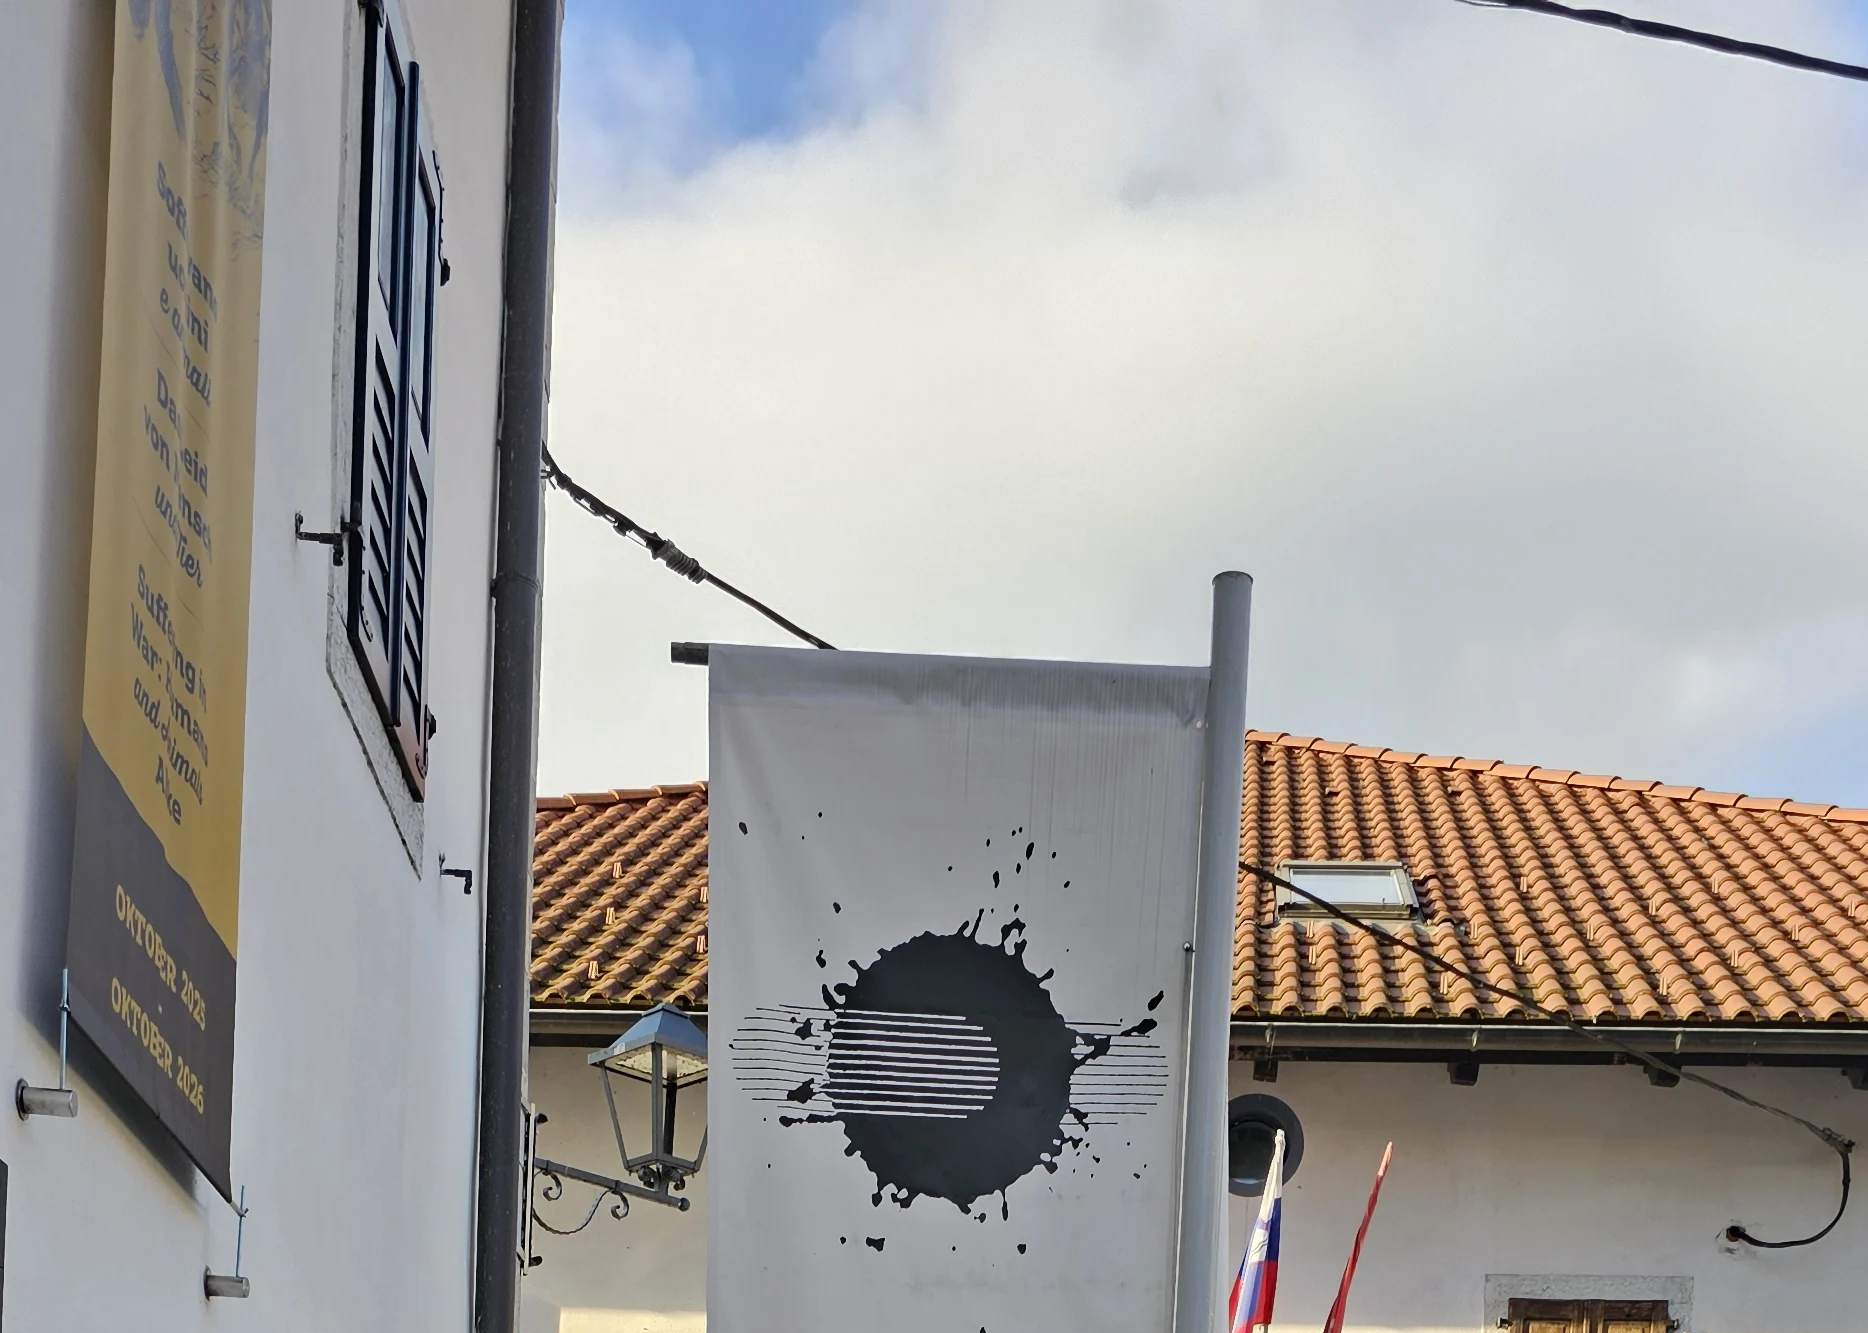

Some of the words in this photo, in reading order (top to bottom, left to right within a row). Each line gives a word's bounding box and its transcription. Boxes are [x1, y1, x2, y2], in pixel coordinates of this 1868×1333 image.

[160, 288, 169, 313] e
[131, 602, 163, 682] War:
[134, 677, 160, 730] and
[115, 884, 176, 993] OKTOBER
[181, 970, 206, 1031] 2025
[111, 977, 172, 1078] OKTOBER
[177, 1056, 204, 1114] 2026
